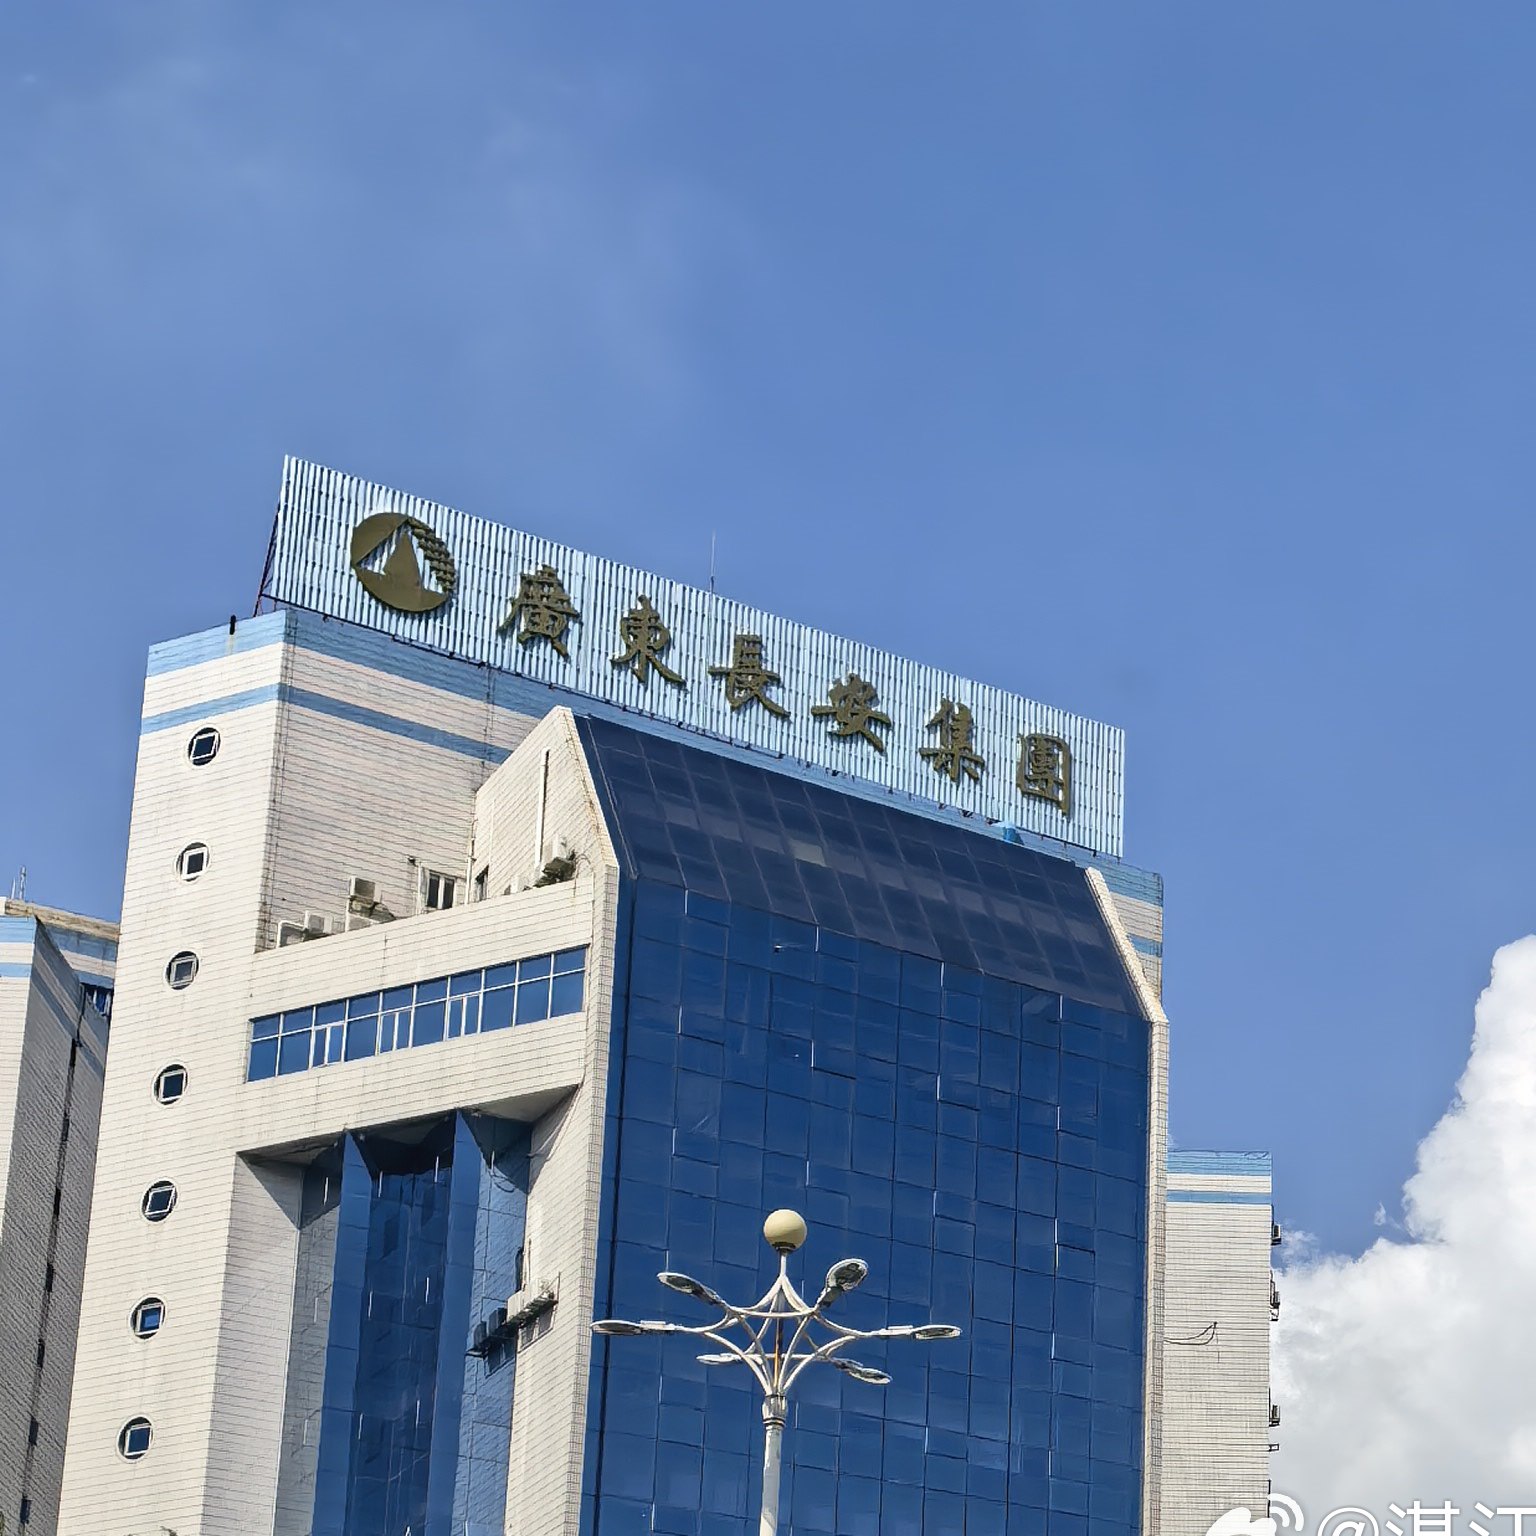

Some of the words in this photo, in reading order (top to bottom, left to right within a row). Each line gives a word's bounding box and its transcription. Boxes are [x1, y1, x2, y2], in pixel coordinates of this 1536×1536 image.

[499, 564, 1073, 818] 廣東長安集團
